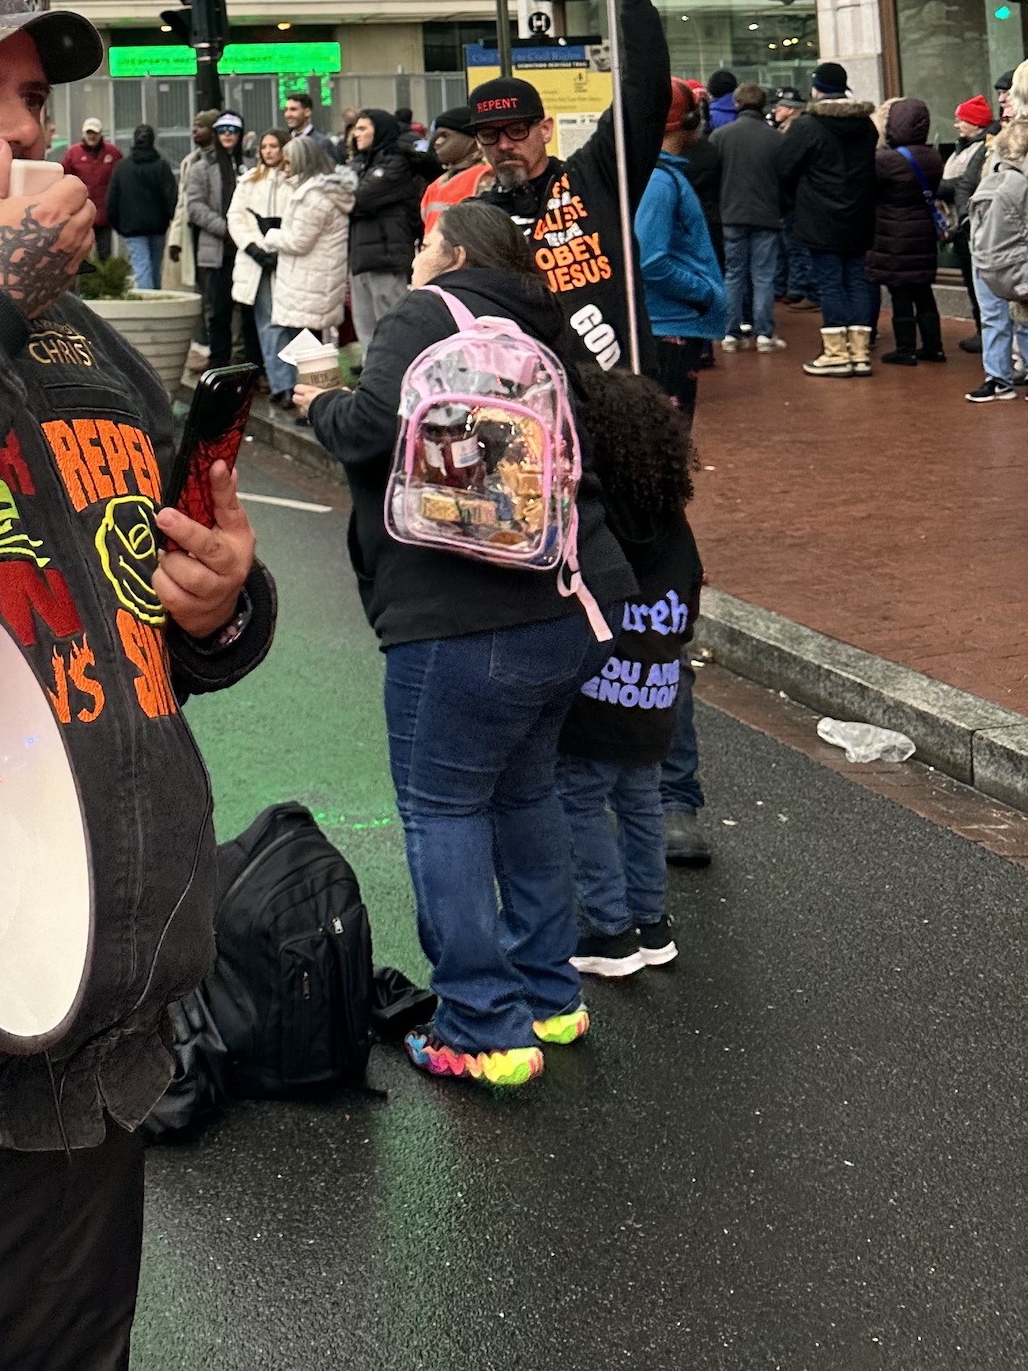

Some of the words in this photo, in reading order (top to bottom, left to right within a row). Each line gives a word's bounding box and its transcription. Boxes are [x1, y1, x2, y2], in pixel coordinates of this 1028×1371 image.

[532, 15, 546, 31] H
[477, 97, 518, 113] REPENT
[535, 232, 602, 271] OBEY
[547, 256, 612, 293] JESUS
[570, 303, 621, 371] GOD
[41, 418, 162, 513] REPEN
[601, 657, 642, 684] OU
